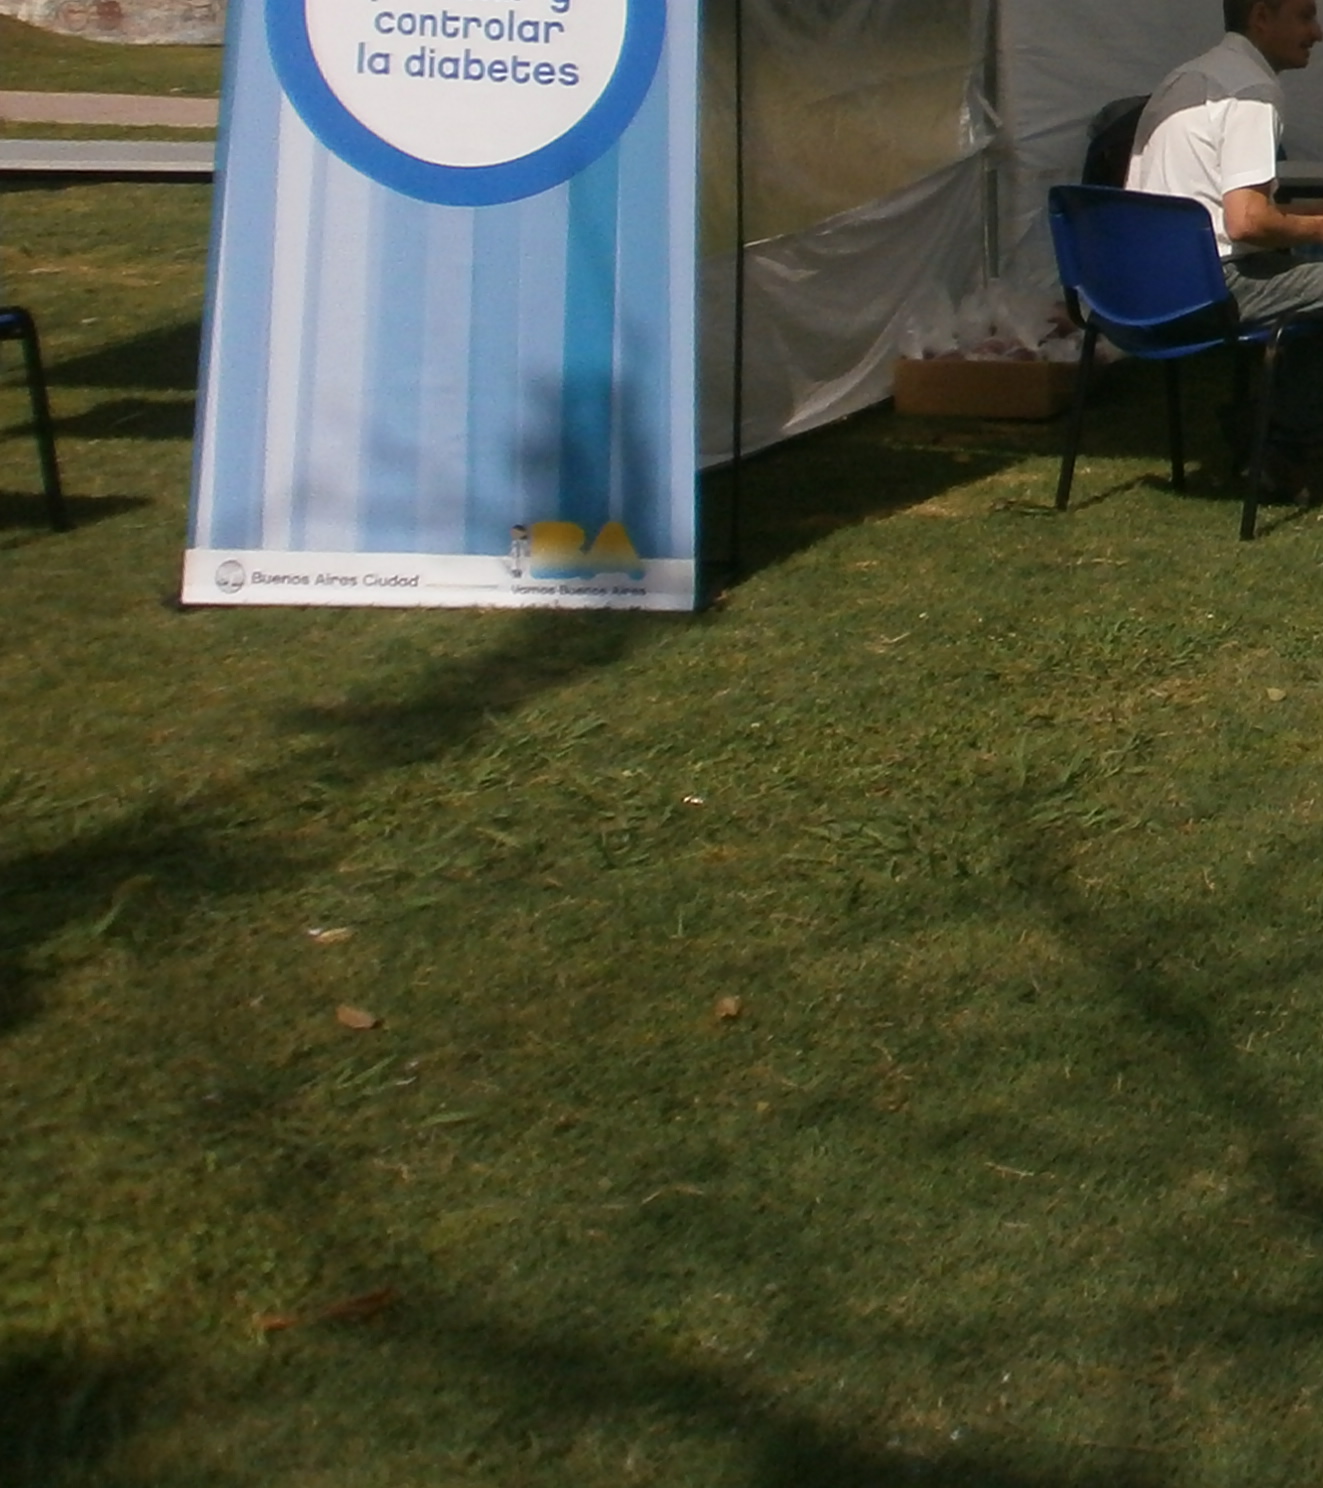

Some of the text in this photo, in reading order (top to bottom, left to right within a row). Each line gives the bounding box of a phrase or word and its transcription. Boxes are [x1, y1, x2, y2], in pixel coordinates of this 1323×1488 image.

[374, 9, 565, 43] controlar
[357, 42, 580, 86] la diabetes
[252, 572, 419, 587] Buenos Aires Ciudad
